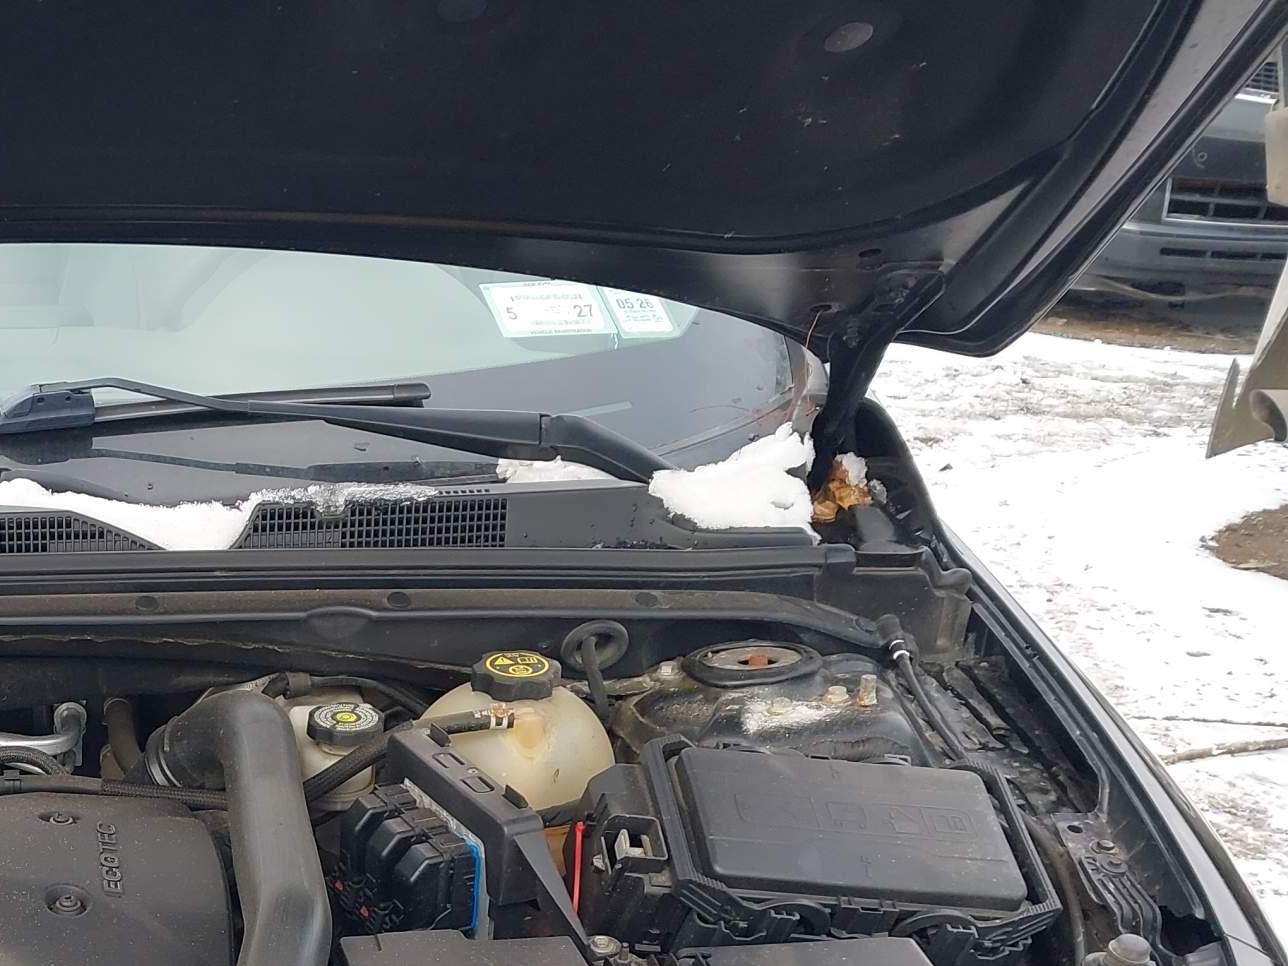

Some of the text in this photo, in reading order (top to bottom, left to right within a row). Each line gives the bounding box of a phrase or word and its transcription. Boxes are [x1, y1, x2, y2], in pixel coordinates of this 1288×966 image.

[505, 304, 593, 320] 5 27
[615, 298, 634, 310] 05
[96, 821, 122, 897] ECOTEC
